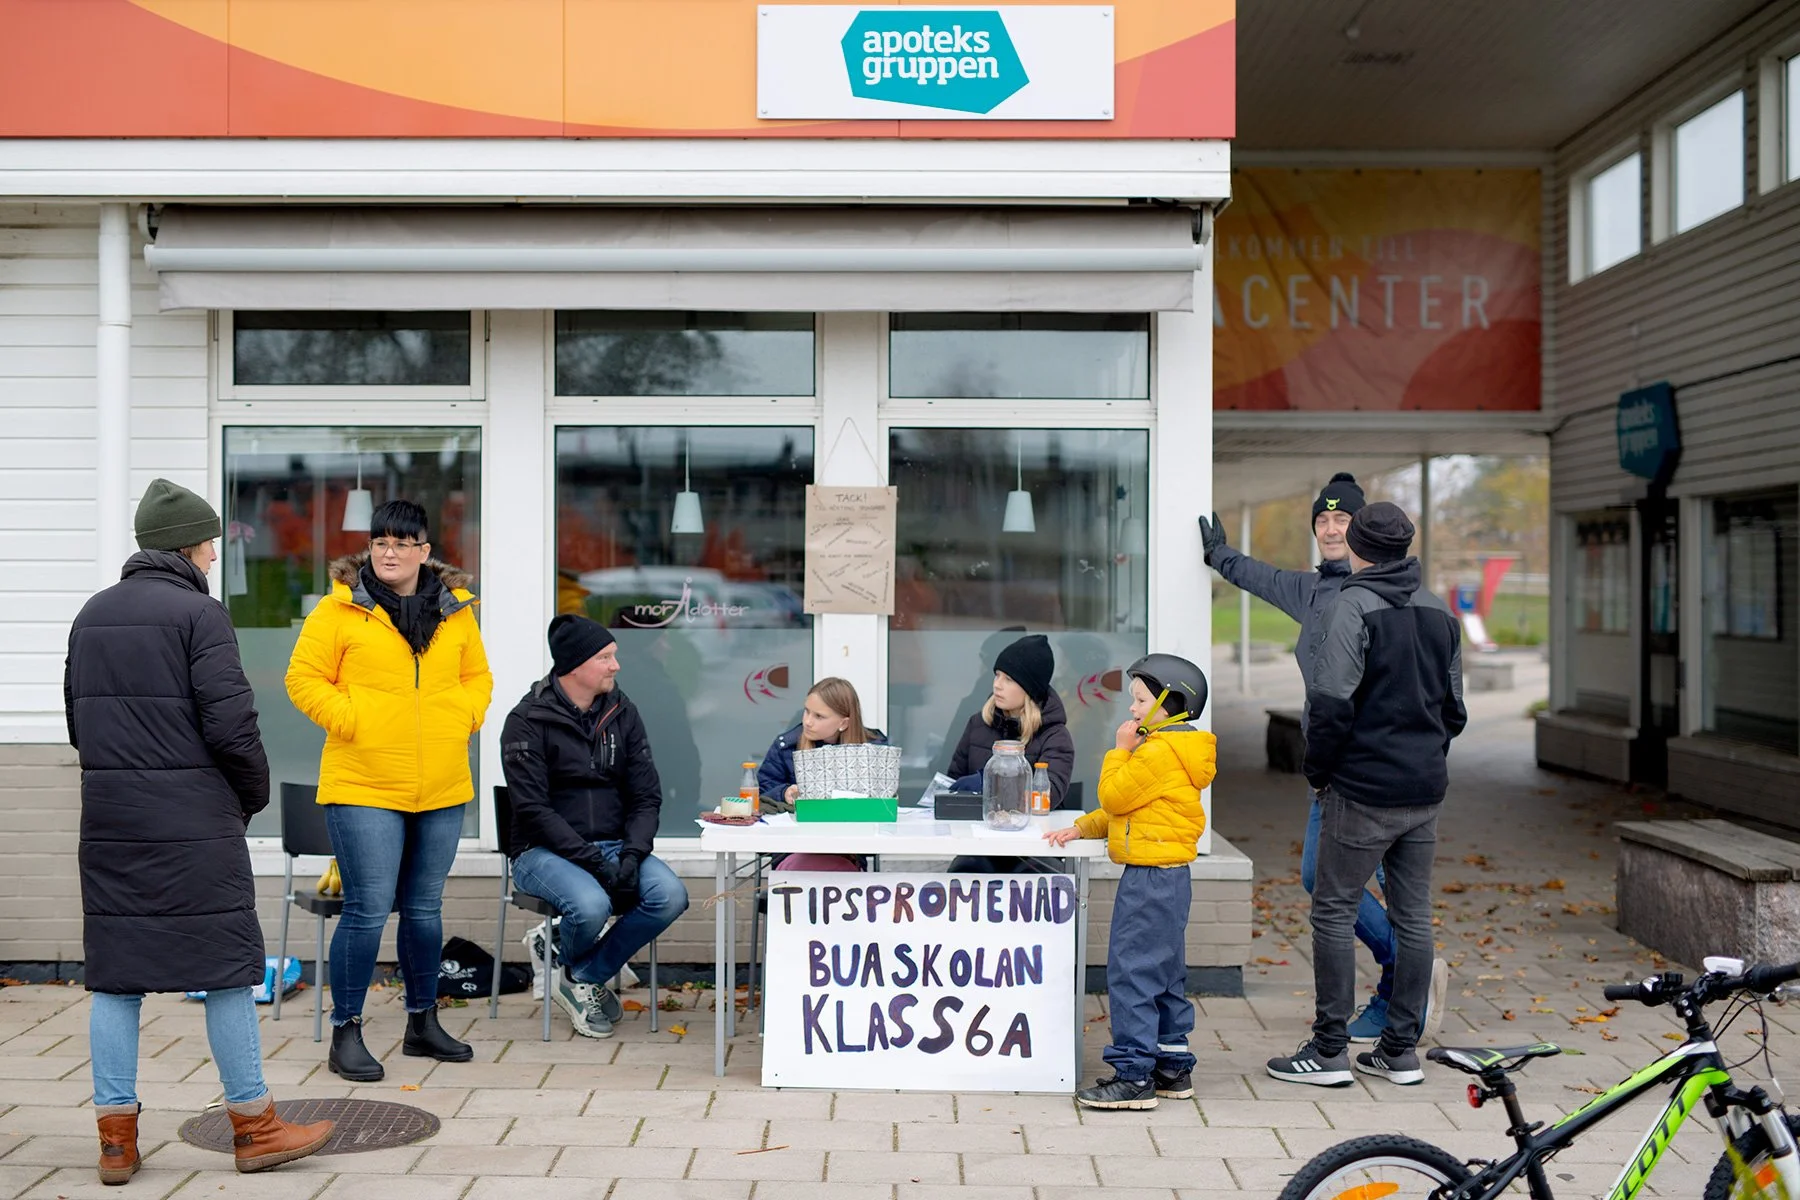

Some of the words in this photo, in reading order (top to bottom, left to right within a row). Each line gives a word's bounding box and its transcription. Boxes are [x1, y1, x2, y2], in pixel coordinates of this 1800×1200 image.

[862, 25, 990, 57] apoteks
[862, 56, 999, 85] gruppen
[834, 493, 868, 503] TACK!
[772, 875, 1076, 925] TIPSPROMENAD
[809, 940, 1044, 988] BUASKOLAN
[1612, 1087, 1687, 1200] COTT
